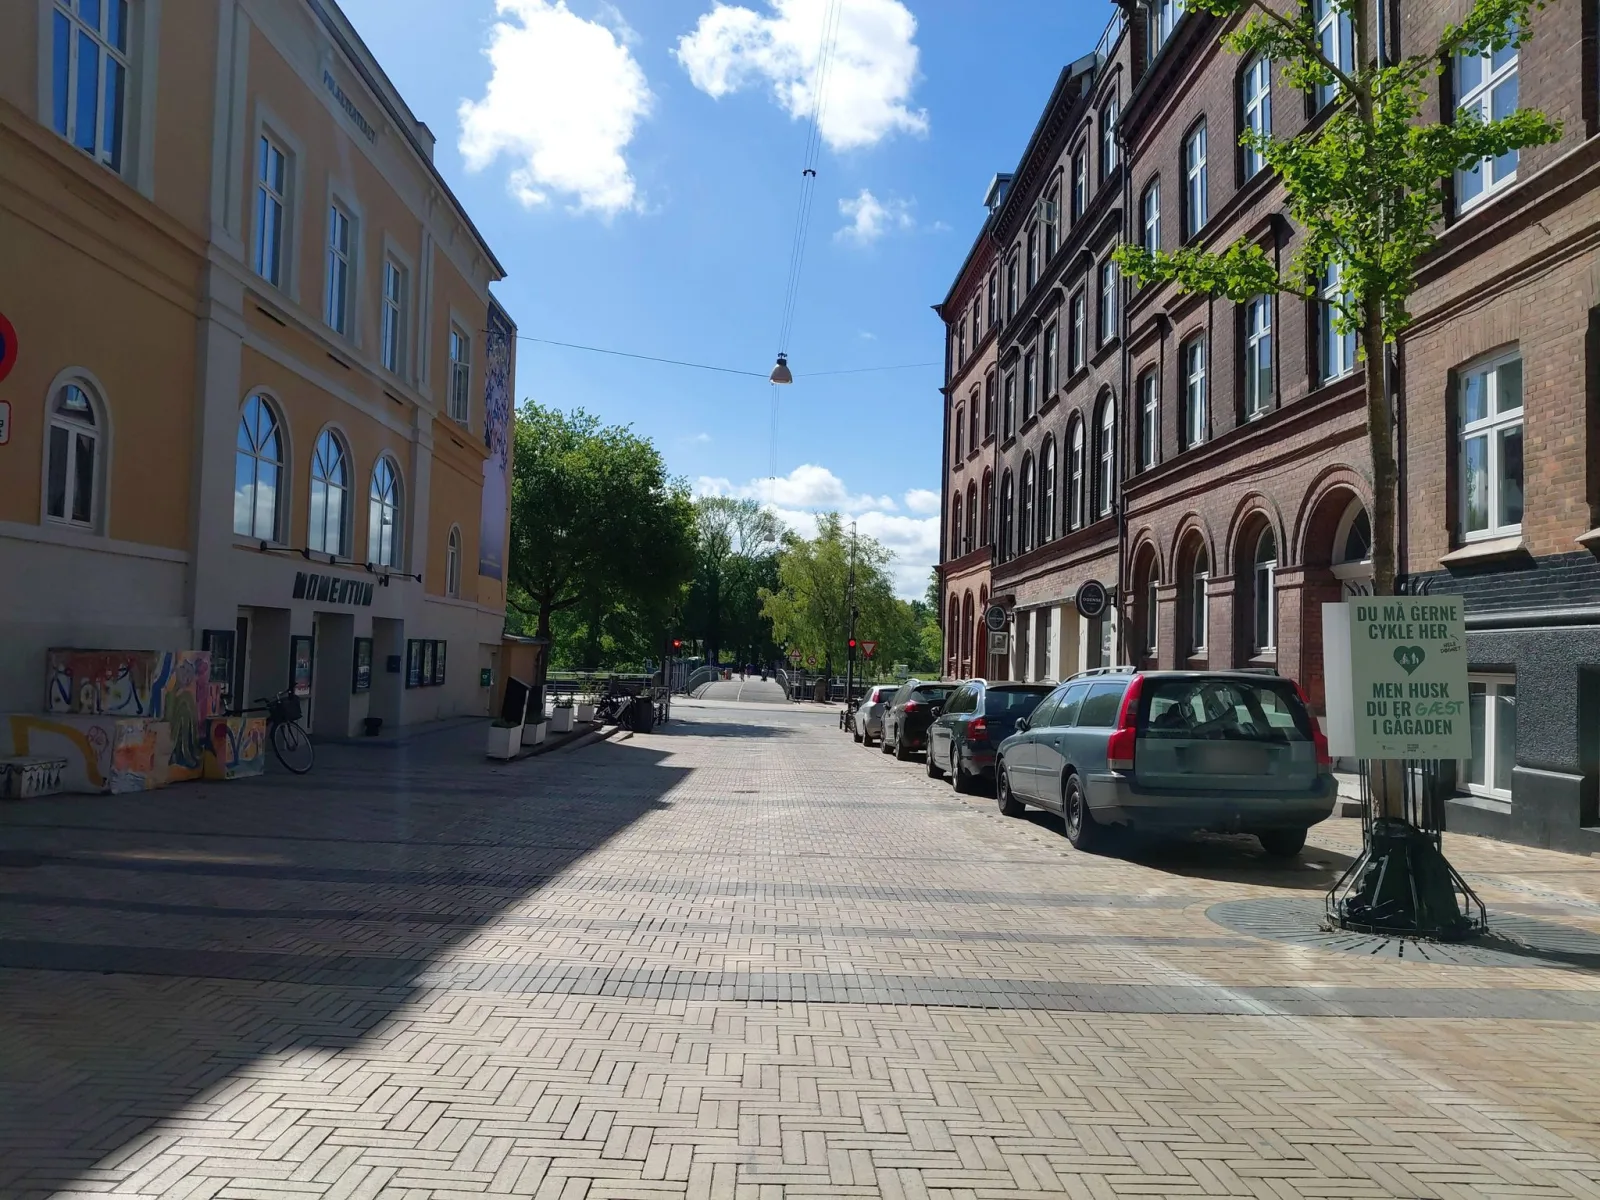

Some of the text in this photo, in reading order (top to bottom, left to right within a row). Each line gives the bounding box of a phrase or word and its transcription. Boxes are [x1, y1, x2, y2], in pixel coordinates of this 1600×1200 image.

[292, 571, 374, 606] MOMENTUM
[1357, 602, 1457, 621] DU MÅ GERNE
[1368, 624, 1448, 639] CYKLE HER
[1373, 683, 1449, 698] MEN HUSK
[1367, 701, 1464, 716] DU ER GÆST
[1373, 715, 1452, 734] I GÅGADEN
